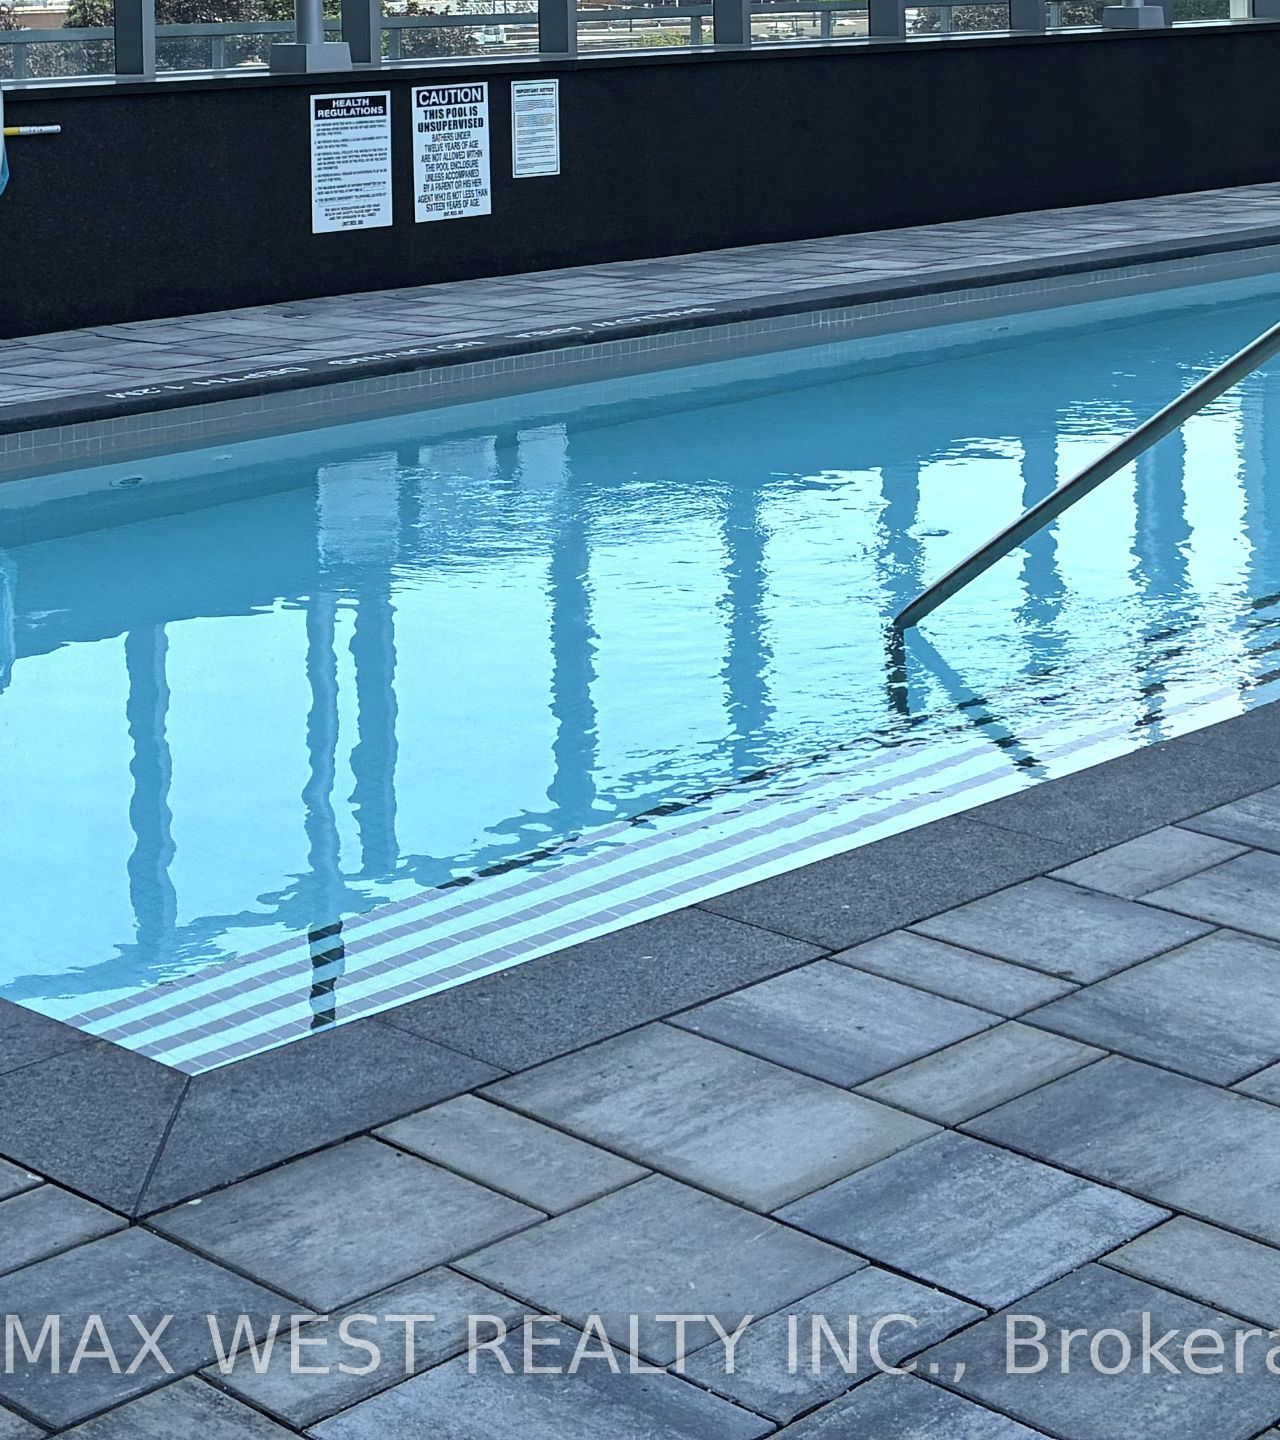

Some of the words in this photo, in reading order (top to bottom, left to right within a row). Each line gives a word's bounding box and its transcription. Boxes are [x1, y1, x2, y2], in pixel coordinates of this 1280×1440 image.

[332, 98, 369, 108] HEALTH
[419, 88, 482, 105] CAUTION
[317, 106, 384, 118] REGULATIONS
[423, 109, 444, 120] THIS
[446, 106, 467, 118] POOL
[469, 106, 478, 117] IS
[418, 117, 484, 133] UNSUPERVISED
